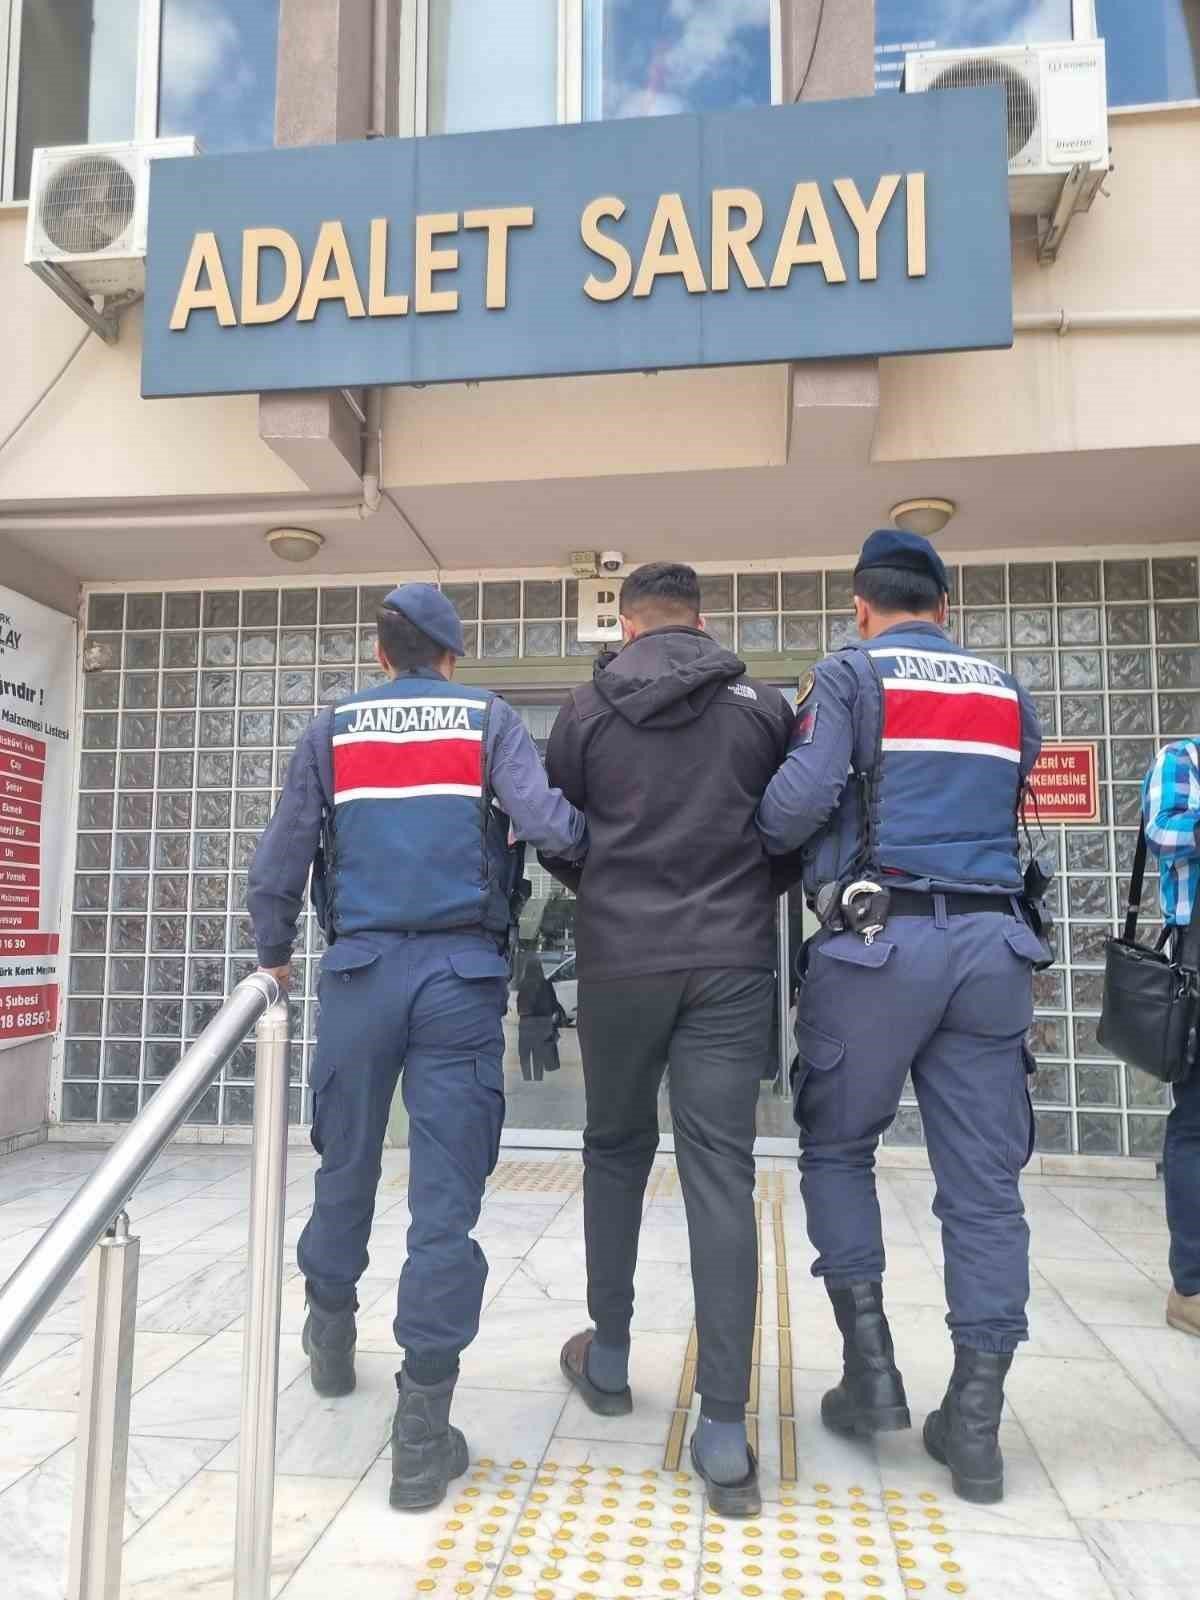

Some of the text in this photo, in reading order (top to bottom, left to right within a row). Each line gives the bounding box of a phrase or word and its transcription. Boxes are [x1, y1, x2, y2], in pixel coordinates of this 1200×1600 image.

[169, 171, 926, 331] ADALET SARAYI
[893, 655, 1005, 687] JANDARMA
[347, 706, 470, 732] JANDARMA
[1033, 754, 1076, 769] LERİ VE
[4, 938, 13, 949] 16
[15, 965, 34, 977] Kent
[6, 993, 39, 1009] Şubesi
